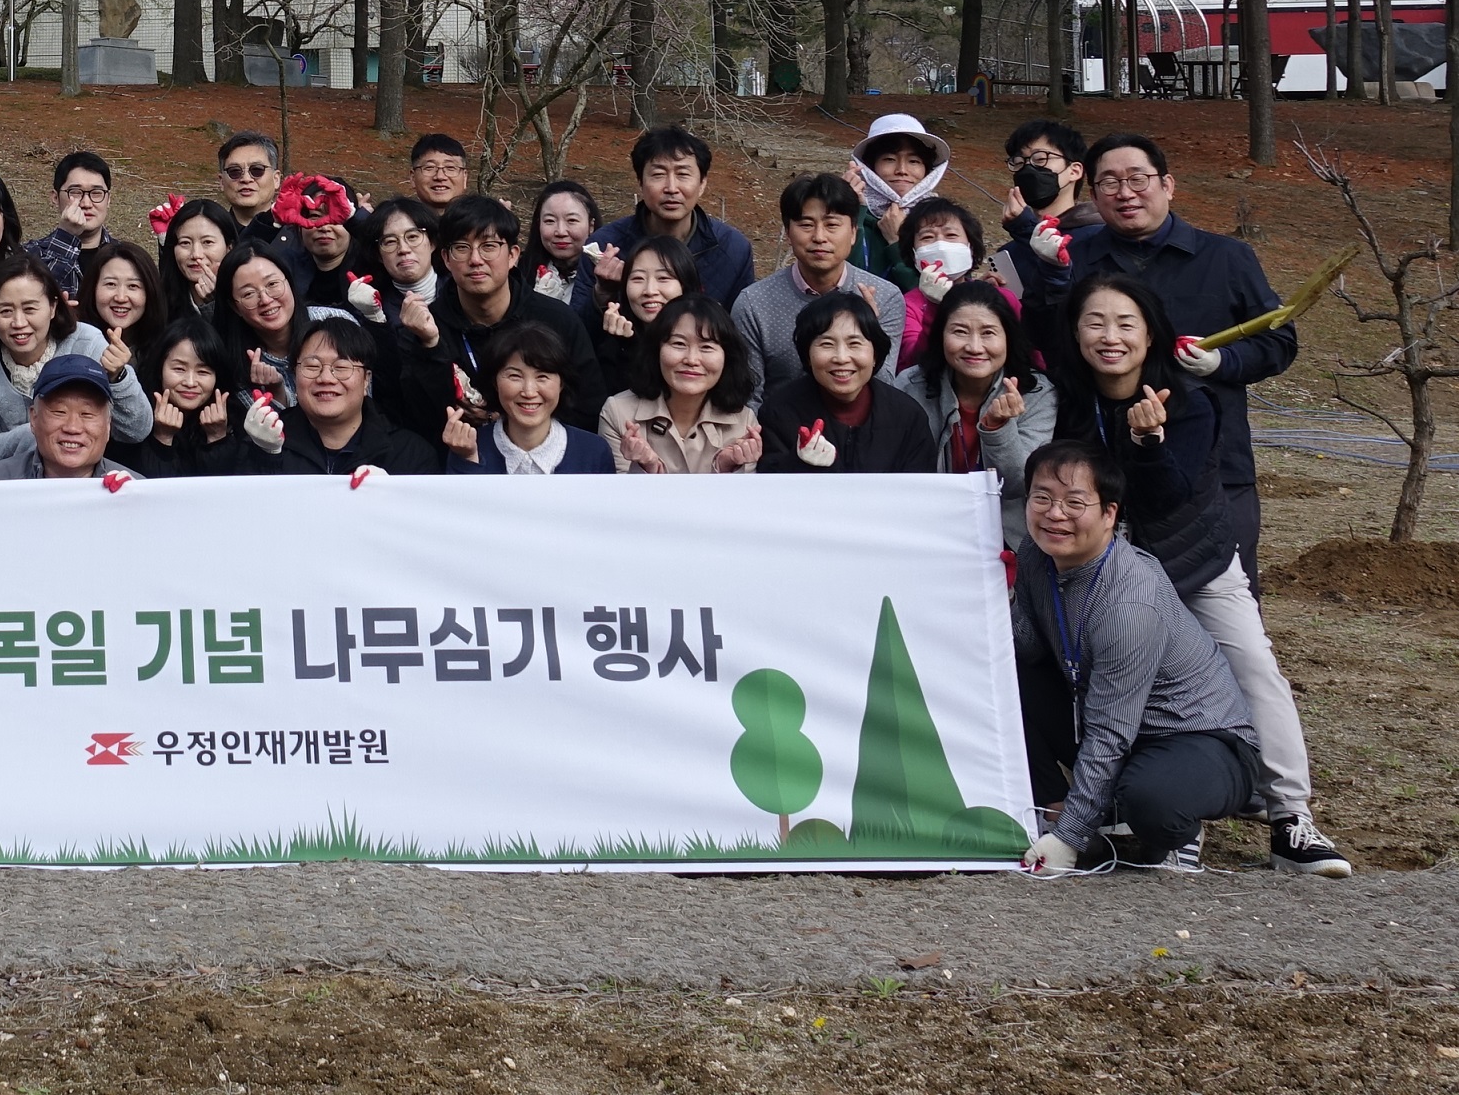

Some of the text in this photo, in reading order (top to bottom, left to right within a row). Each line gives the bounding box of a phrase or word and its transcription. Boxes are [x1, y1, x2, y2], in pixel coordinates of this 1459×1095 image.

[136, 608, 265, 685] 기념
[292, 607, 562, 683] 나무심기
[583, 605, 724, 682] 행사
[153, 729, 390, 767] 우정인재개발원
